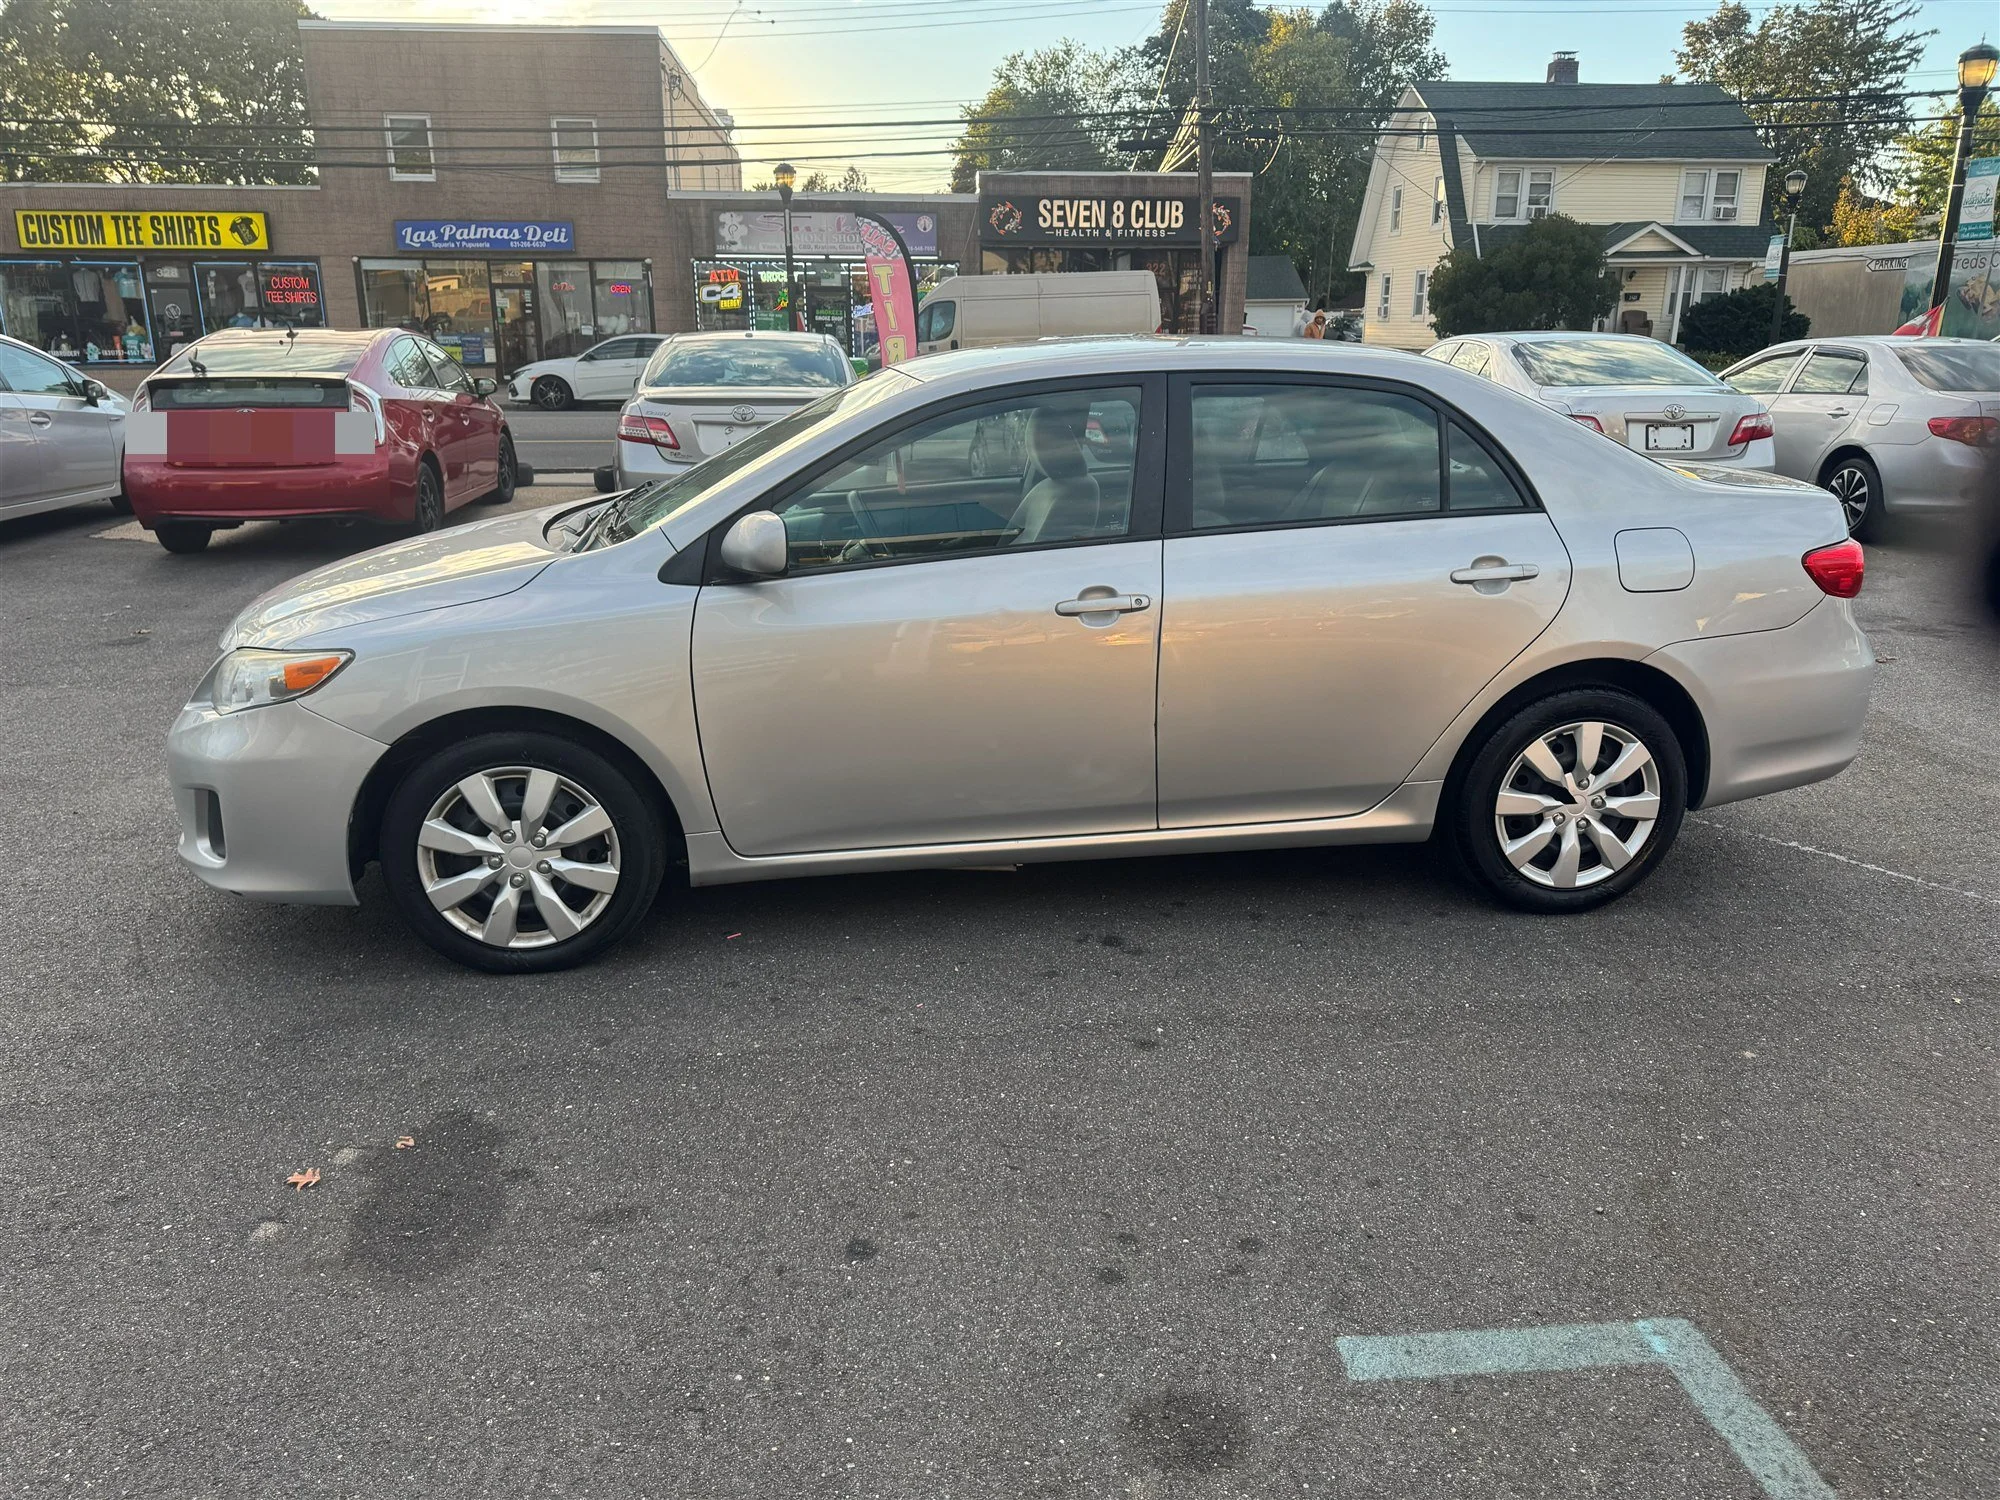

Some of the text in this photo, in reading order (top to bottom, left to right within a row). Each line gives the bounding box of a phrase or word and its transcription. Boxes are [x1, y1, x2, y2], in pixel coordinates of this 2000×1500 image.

[1038, 198, 1184, 229] SEVEN 8 CLUB
[23, 213, 106, 246] CUSTOM
[111, 214, 145, 246] TEE
[150, 214, 222, 247] SHIRTS
[402, 224, 569, 247] Las Palmas Deli
[1056, 228, 1166, 238] HEALTH & FITNESS
[1874, 258, 1907, 270] PARKING
[156, 267, 178, 278] 328
[709, 270, 739, 282] ATM
[271, 276, 310, 289] CUSTOM
[610, 284, 631, 294] OPEN
[700, 282, 742, 303] C4
[266, 291, 317, 304] TEE SHIRTS
[720, 299, 742, 308] ENERGY
